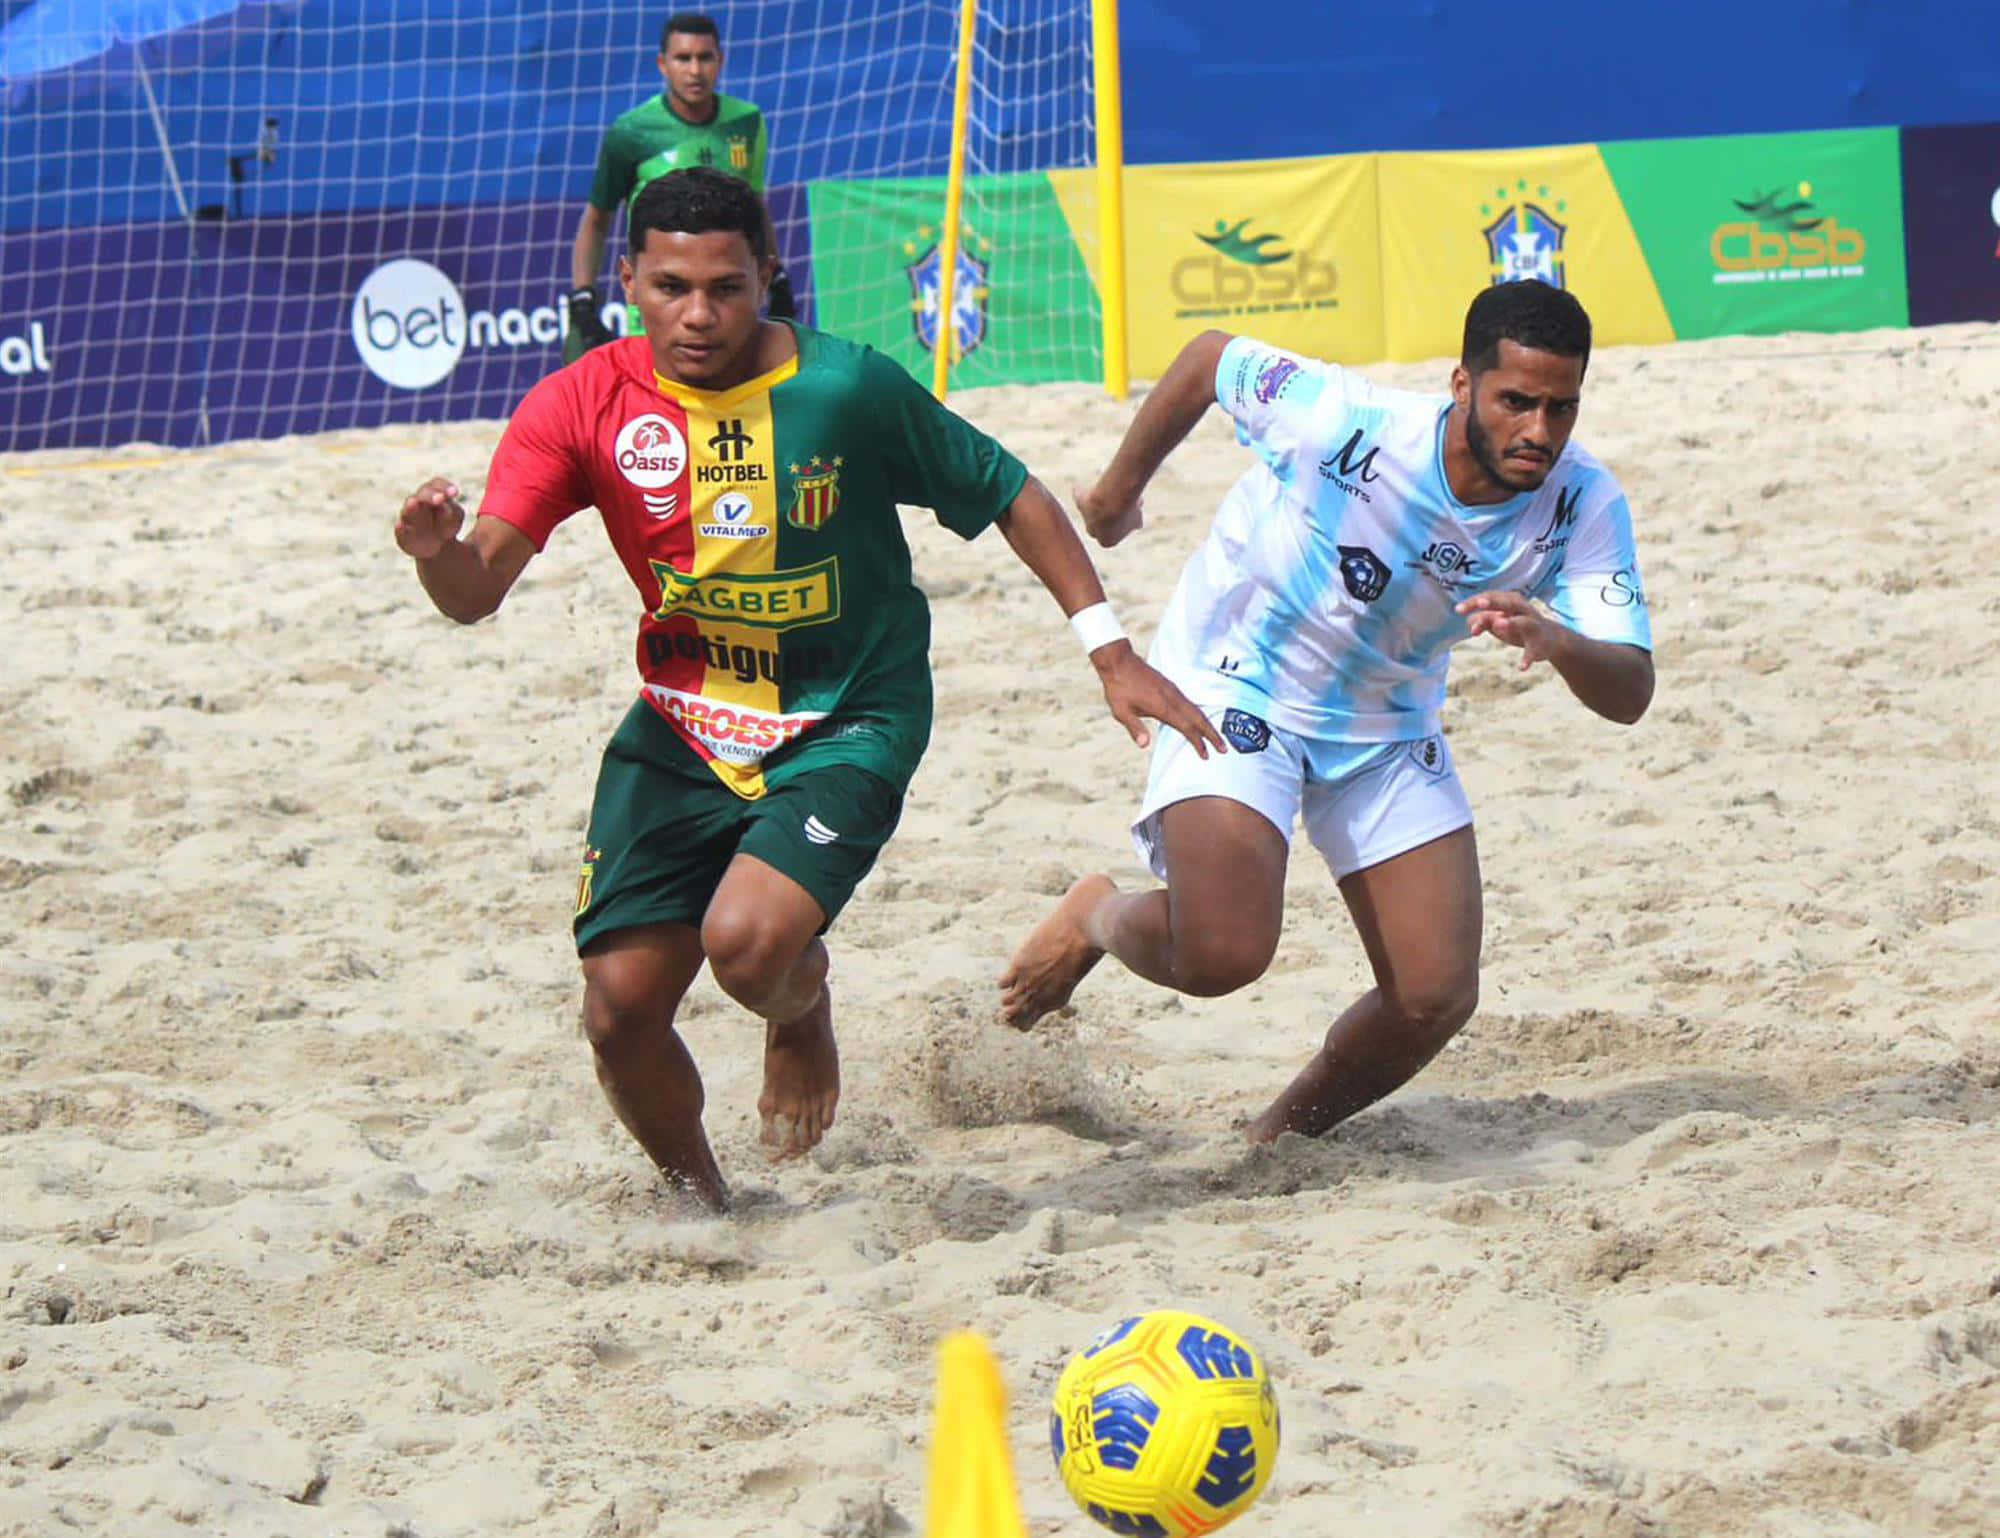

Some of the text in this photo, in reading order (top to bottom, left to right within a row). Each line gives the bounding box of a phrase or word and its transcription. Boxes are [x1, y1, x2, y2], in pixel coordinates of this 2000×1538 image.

[362, 296, 457, 351] bet
[619, 449, 680, 472] Oasis
[696, 464, 769, 483] HOTBEL
[1318, 465, 1372, 504] SPORTS
[701, 525, 768, 538] VITALMED
[654, 692, 822, 748] OROEST
